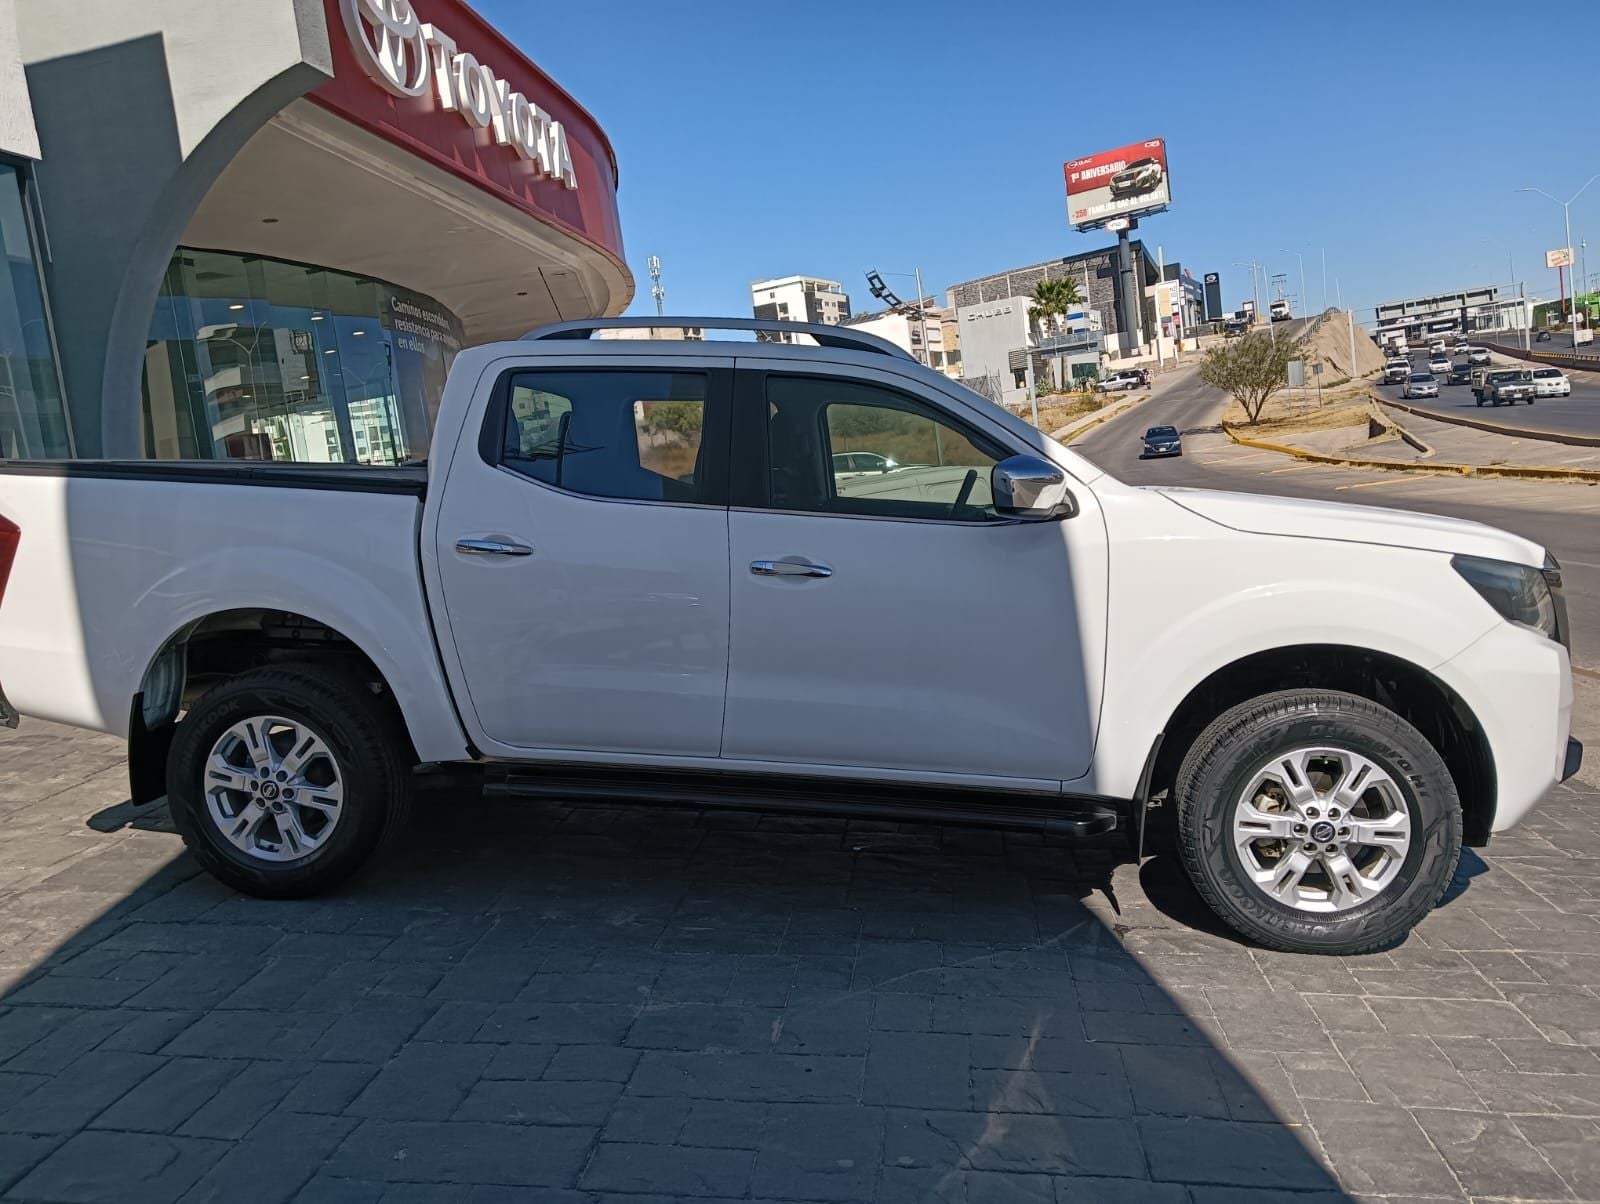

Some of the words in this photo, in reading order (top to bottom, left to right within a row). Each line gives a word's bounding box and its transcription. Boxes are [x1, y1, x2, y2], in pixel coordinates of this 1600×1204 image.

[420, 23, 578, 190] TOYOTA
[391, 296, 422, 319] Caminos
[394, 317, 430, 339] resistencia
[398, 337, 409, 350] en
[408, 336, 425, 353] ellos
